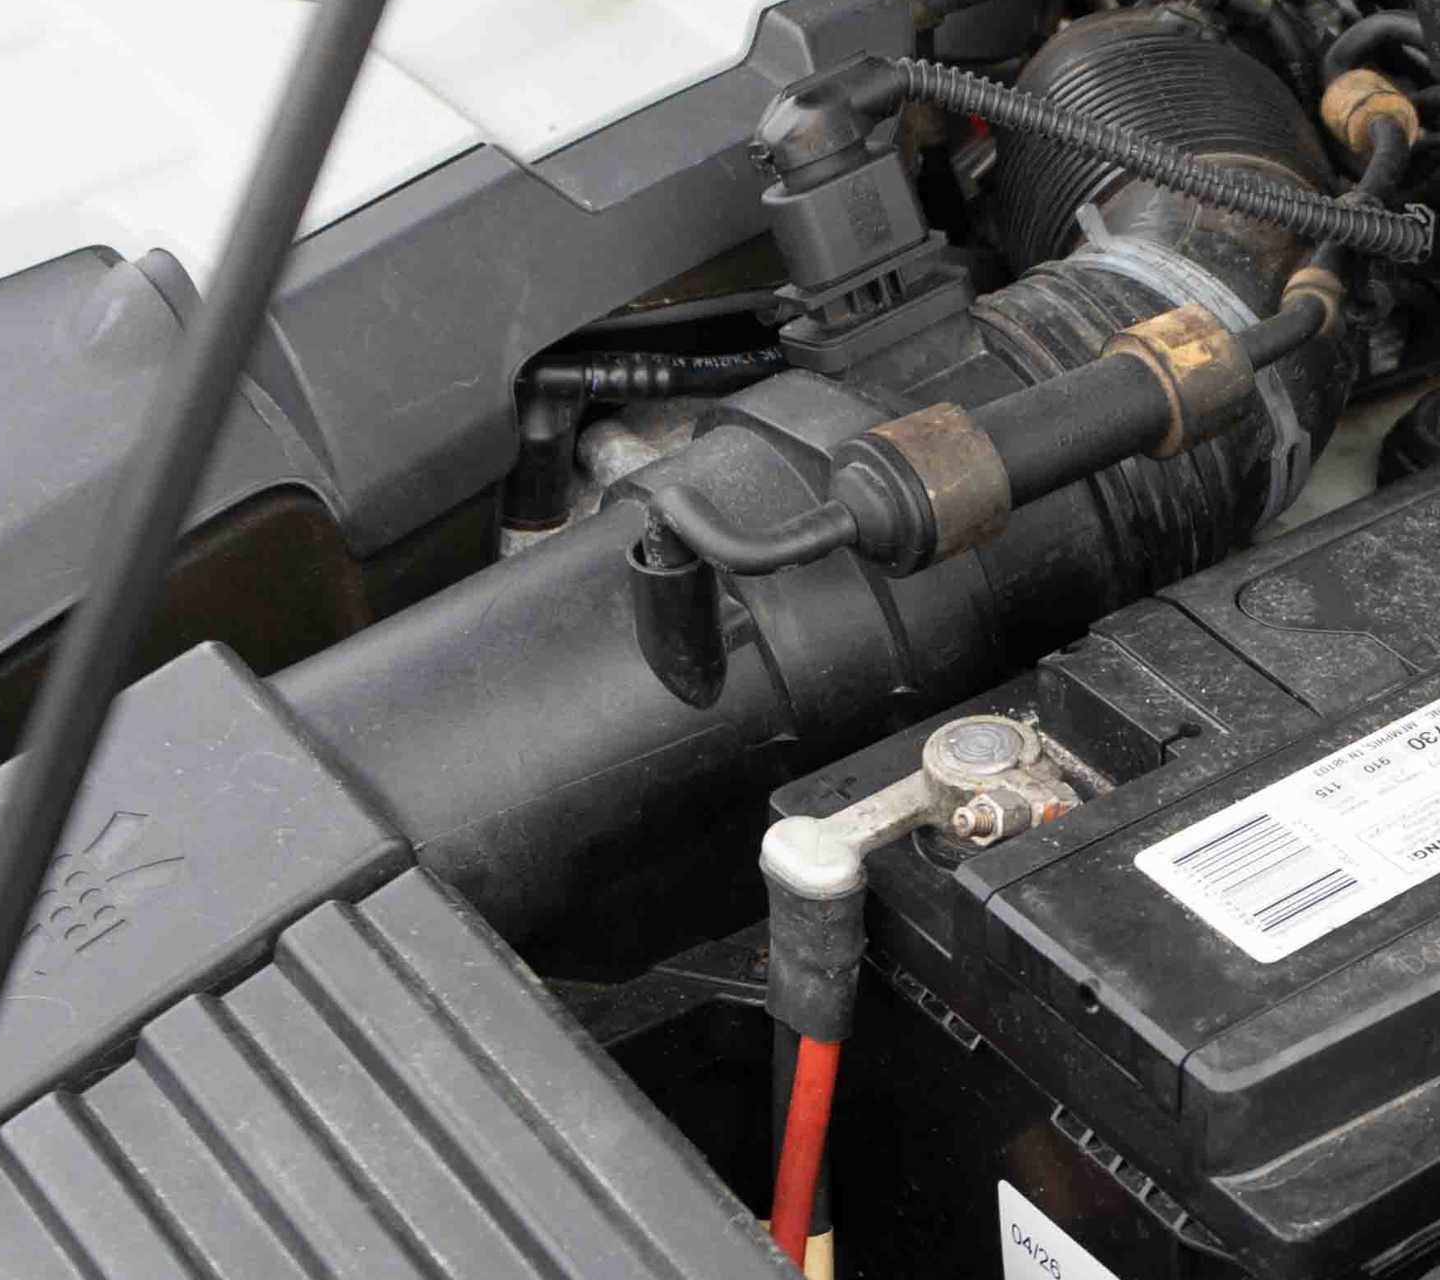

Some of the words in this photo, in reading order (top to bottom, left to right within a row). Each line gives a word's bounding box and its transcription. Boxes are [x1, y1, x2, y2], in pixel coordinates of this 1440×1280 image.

[1363, 756, 1391, 774] 910
[1314, 782, 1342, 799] 115
[1011, 1223, 1061, 1280] 04/26
